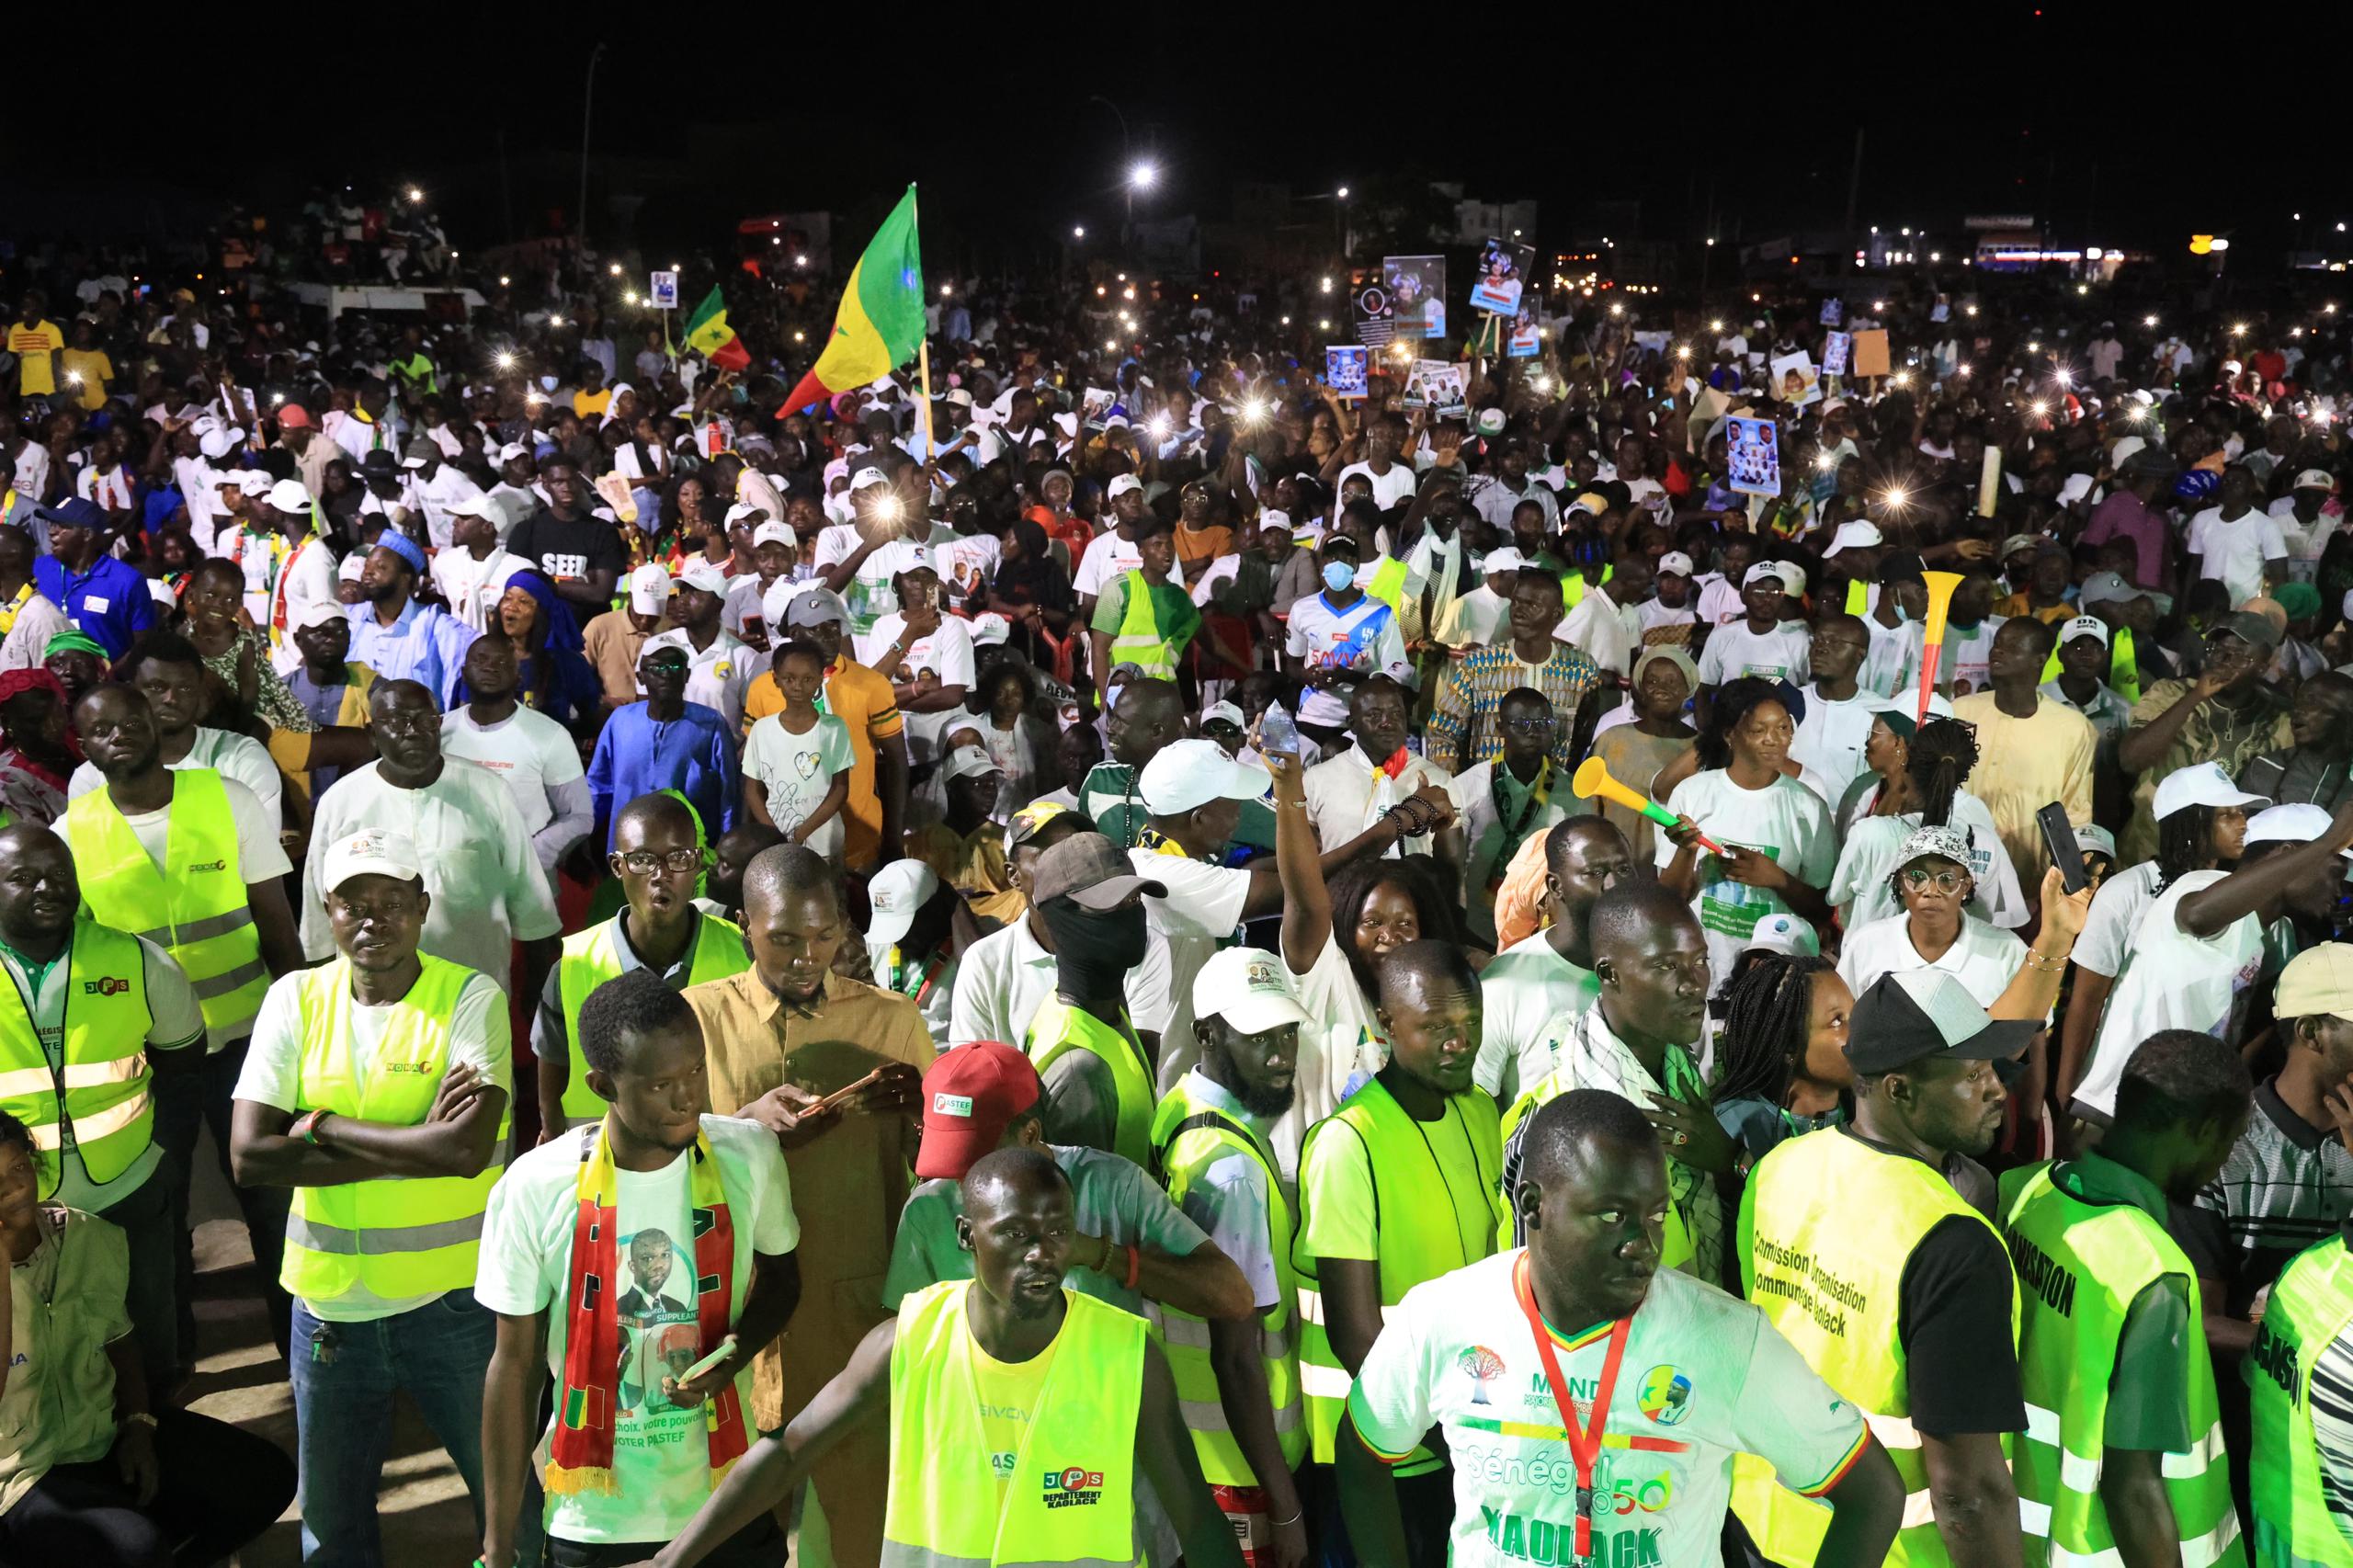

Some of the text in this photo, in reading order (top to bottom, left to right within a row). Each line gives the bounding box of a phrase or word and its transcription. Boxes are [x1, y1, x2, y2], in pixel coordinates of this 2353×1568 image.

[643, 1418, 666, 1430] votre
[647, 1432, 685, 1448] PASTEF
[1043, 1467, 1104, 1491] JPS
[1043, 1491, 1102, 1502] DEPARTEMENT
